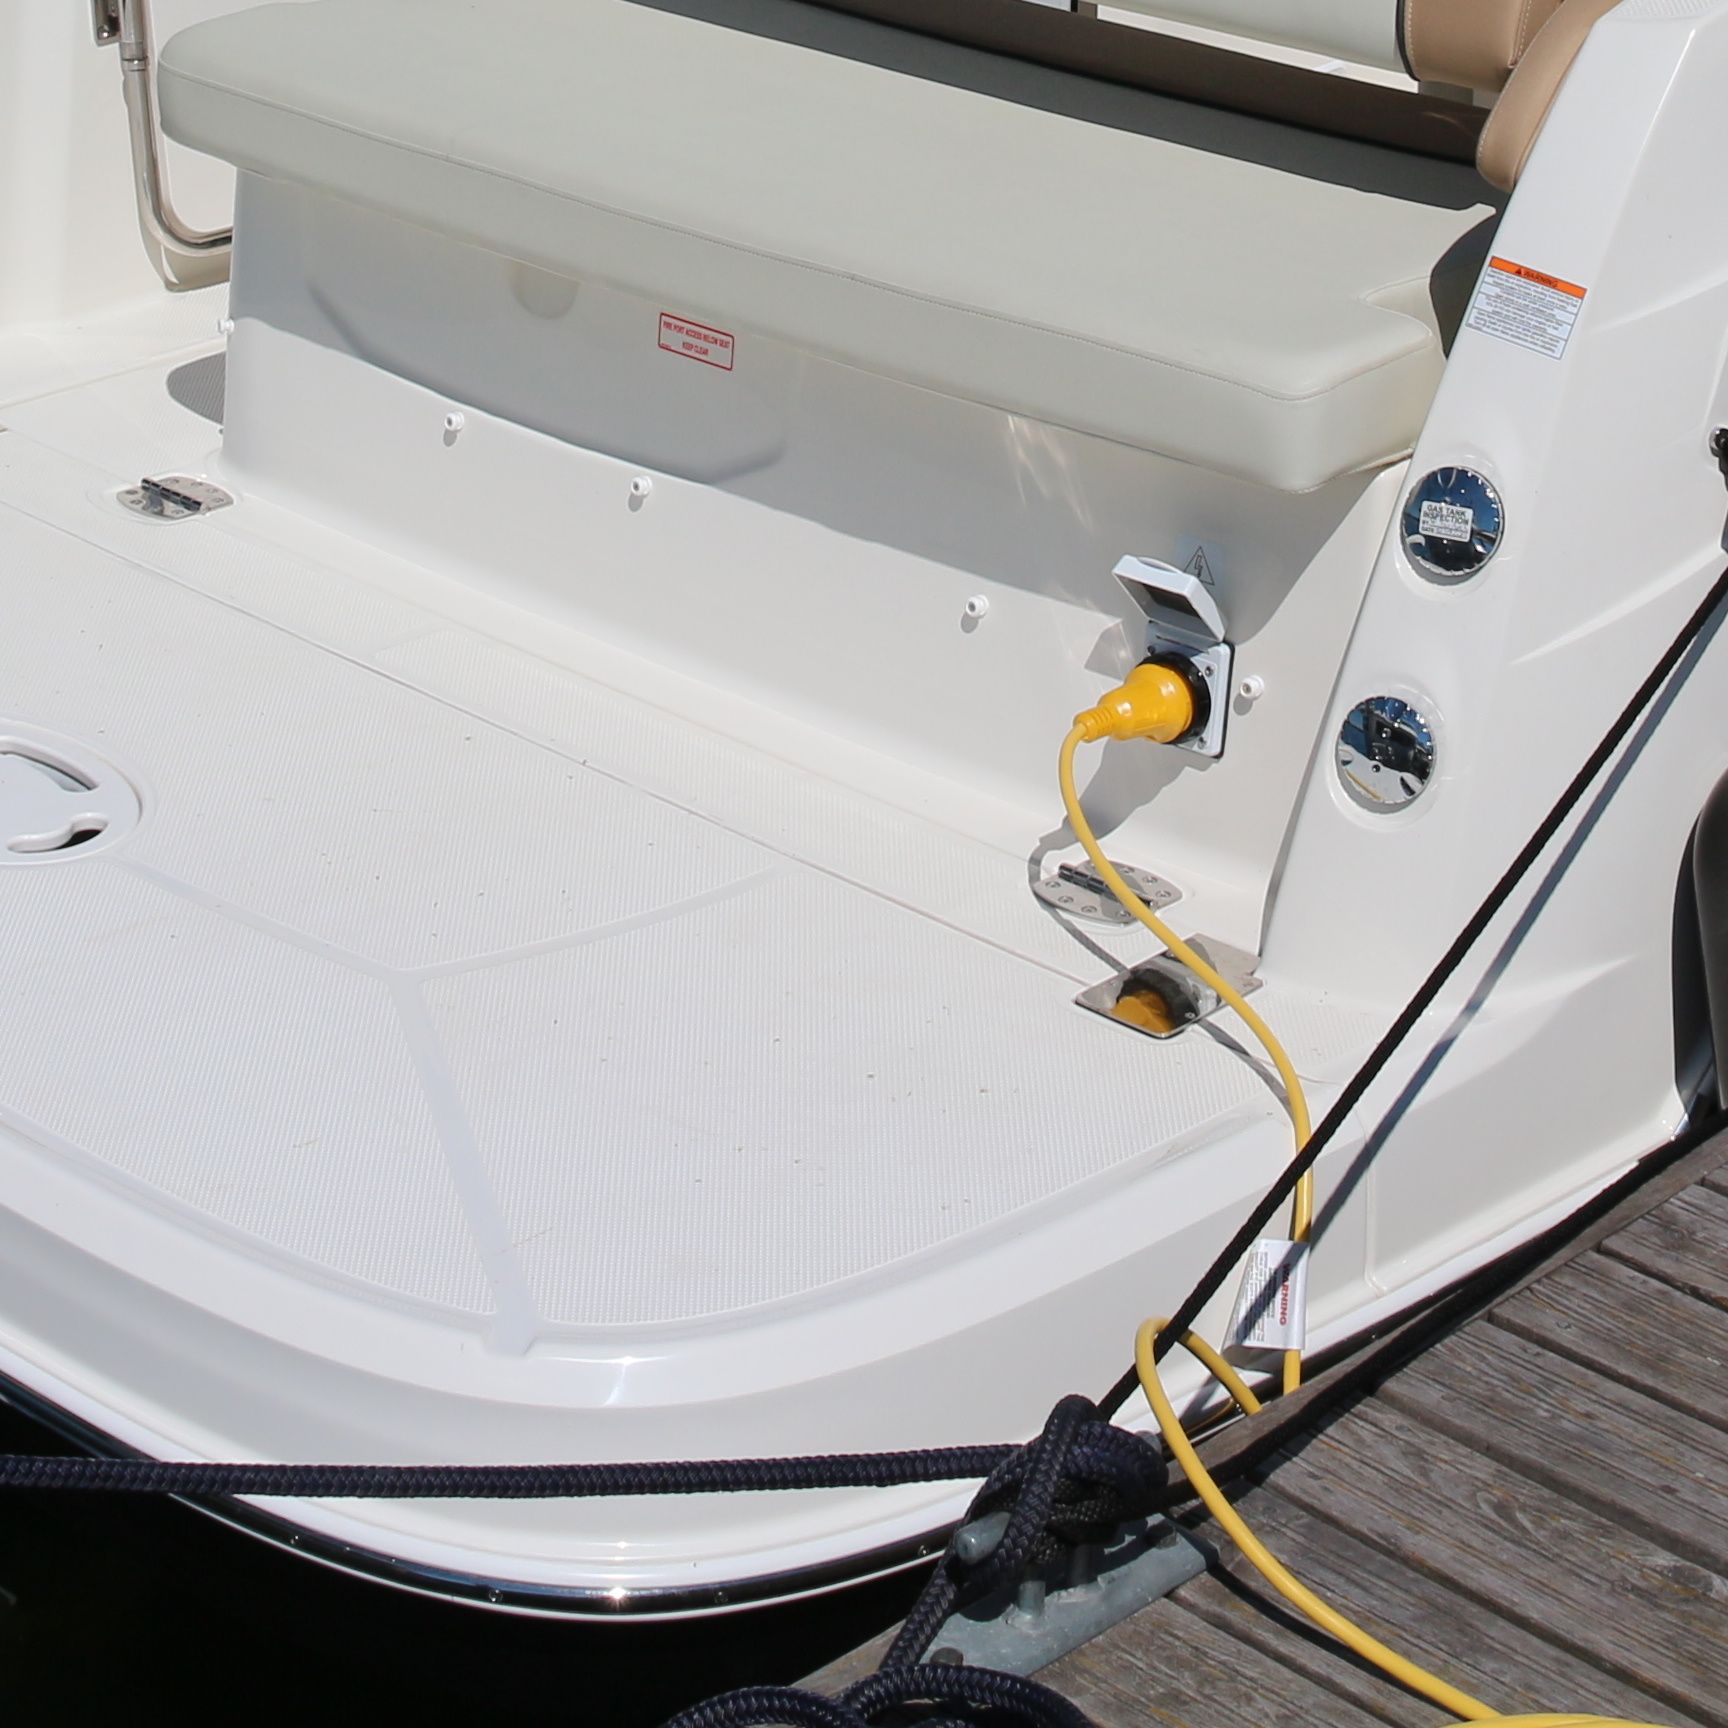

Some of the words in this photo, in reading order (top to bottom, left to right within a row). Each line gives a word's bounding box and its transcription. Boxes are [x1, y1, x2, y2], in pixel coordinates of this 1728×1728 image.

[1422, 510, 1469, 525] INSPECTION
[1427, 504, 1443, 513] GAS
[1446, 506, 1466, 518] TANK
[1279, 1263, 1291, 1326] WARNING
